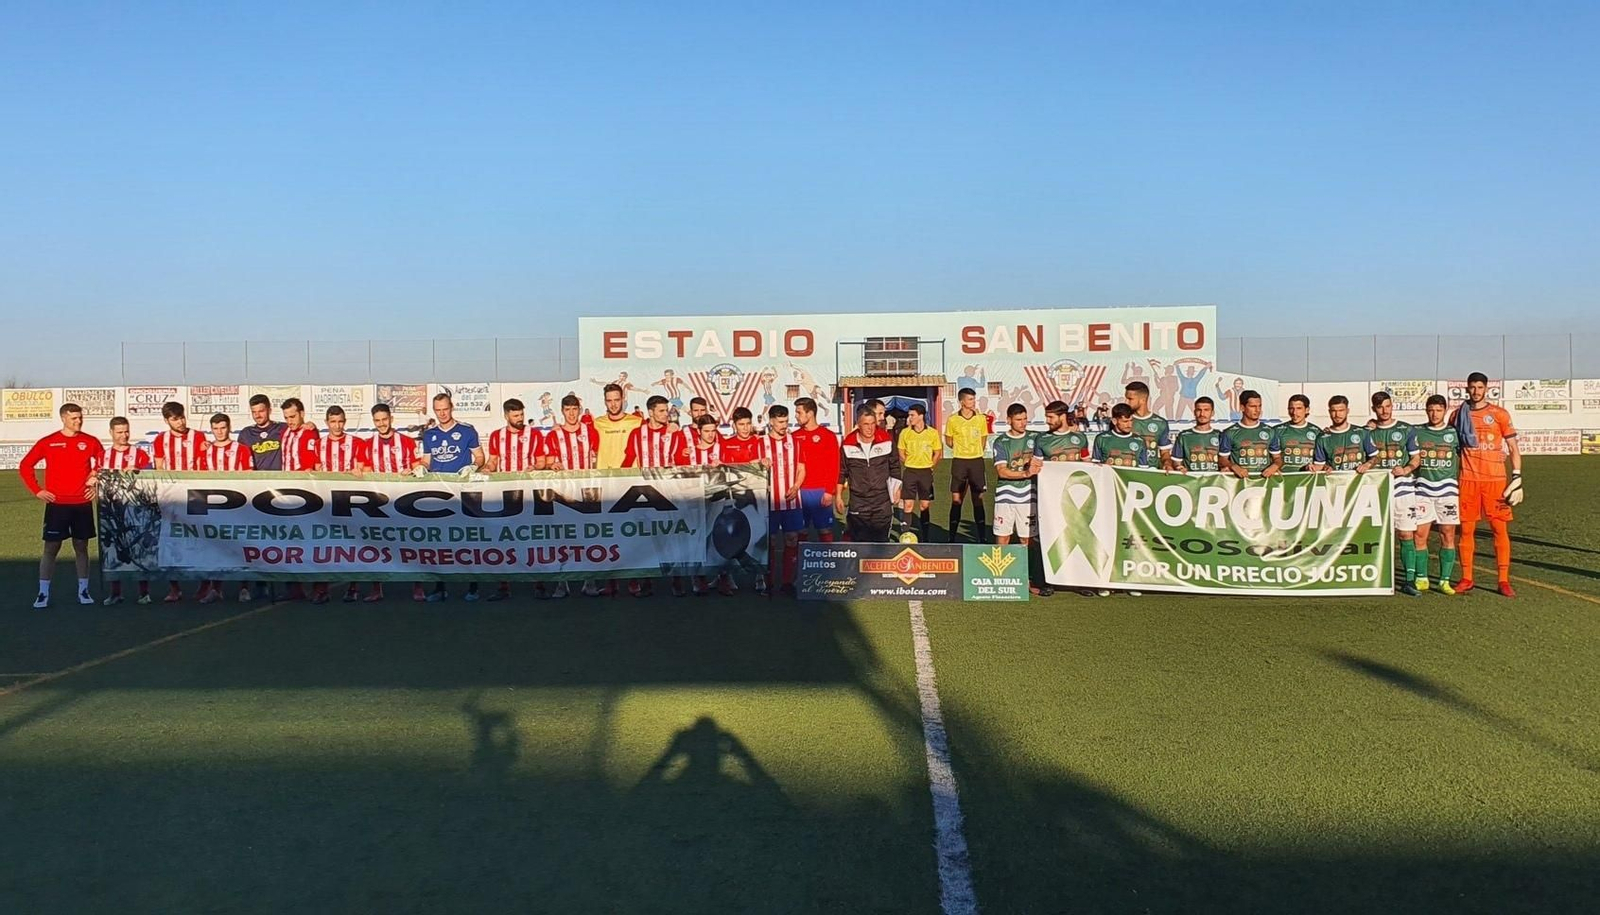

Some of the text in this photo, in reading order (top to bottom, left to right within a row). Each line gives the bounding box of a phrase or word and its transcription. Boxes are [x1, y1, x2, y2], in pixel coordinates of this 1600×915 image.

[961, 321, 1205, 354] SAN BENITO
[603, 329, 815, 358] ESTADIO
[11, 391, 53, 401] OBULCO
[314, 394, 351, 404] MADRIDISTA
[1190, 462, 1199, 470] EL
[1430, 459, 1452, 467] EJIDO
[187, 485, 679, 518] PORCUNA
[1121, 481, 1383, 529] PORCUNA
[169, 518, 697, 542] EN DEFENSA DEL SECTOR DEL ACEITE DE OLIVA,
[243, 544, 621, 567] POR UNOS PRECIOS JUSTOS
[803, 549, 858, 558] Creciendo
[802, 559, 836, 570] juntos
[863, 561, 896, 571] ACEITES
[1122, 559, 1379, 584] POR UN PRECIO JUSTO
[971, 577, 1023, 586] CAJA RURAL
[870, 586, 947, 596] www.ibolca.com
[978, 586, 1017, 594] DEL SUR
